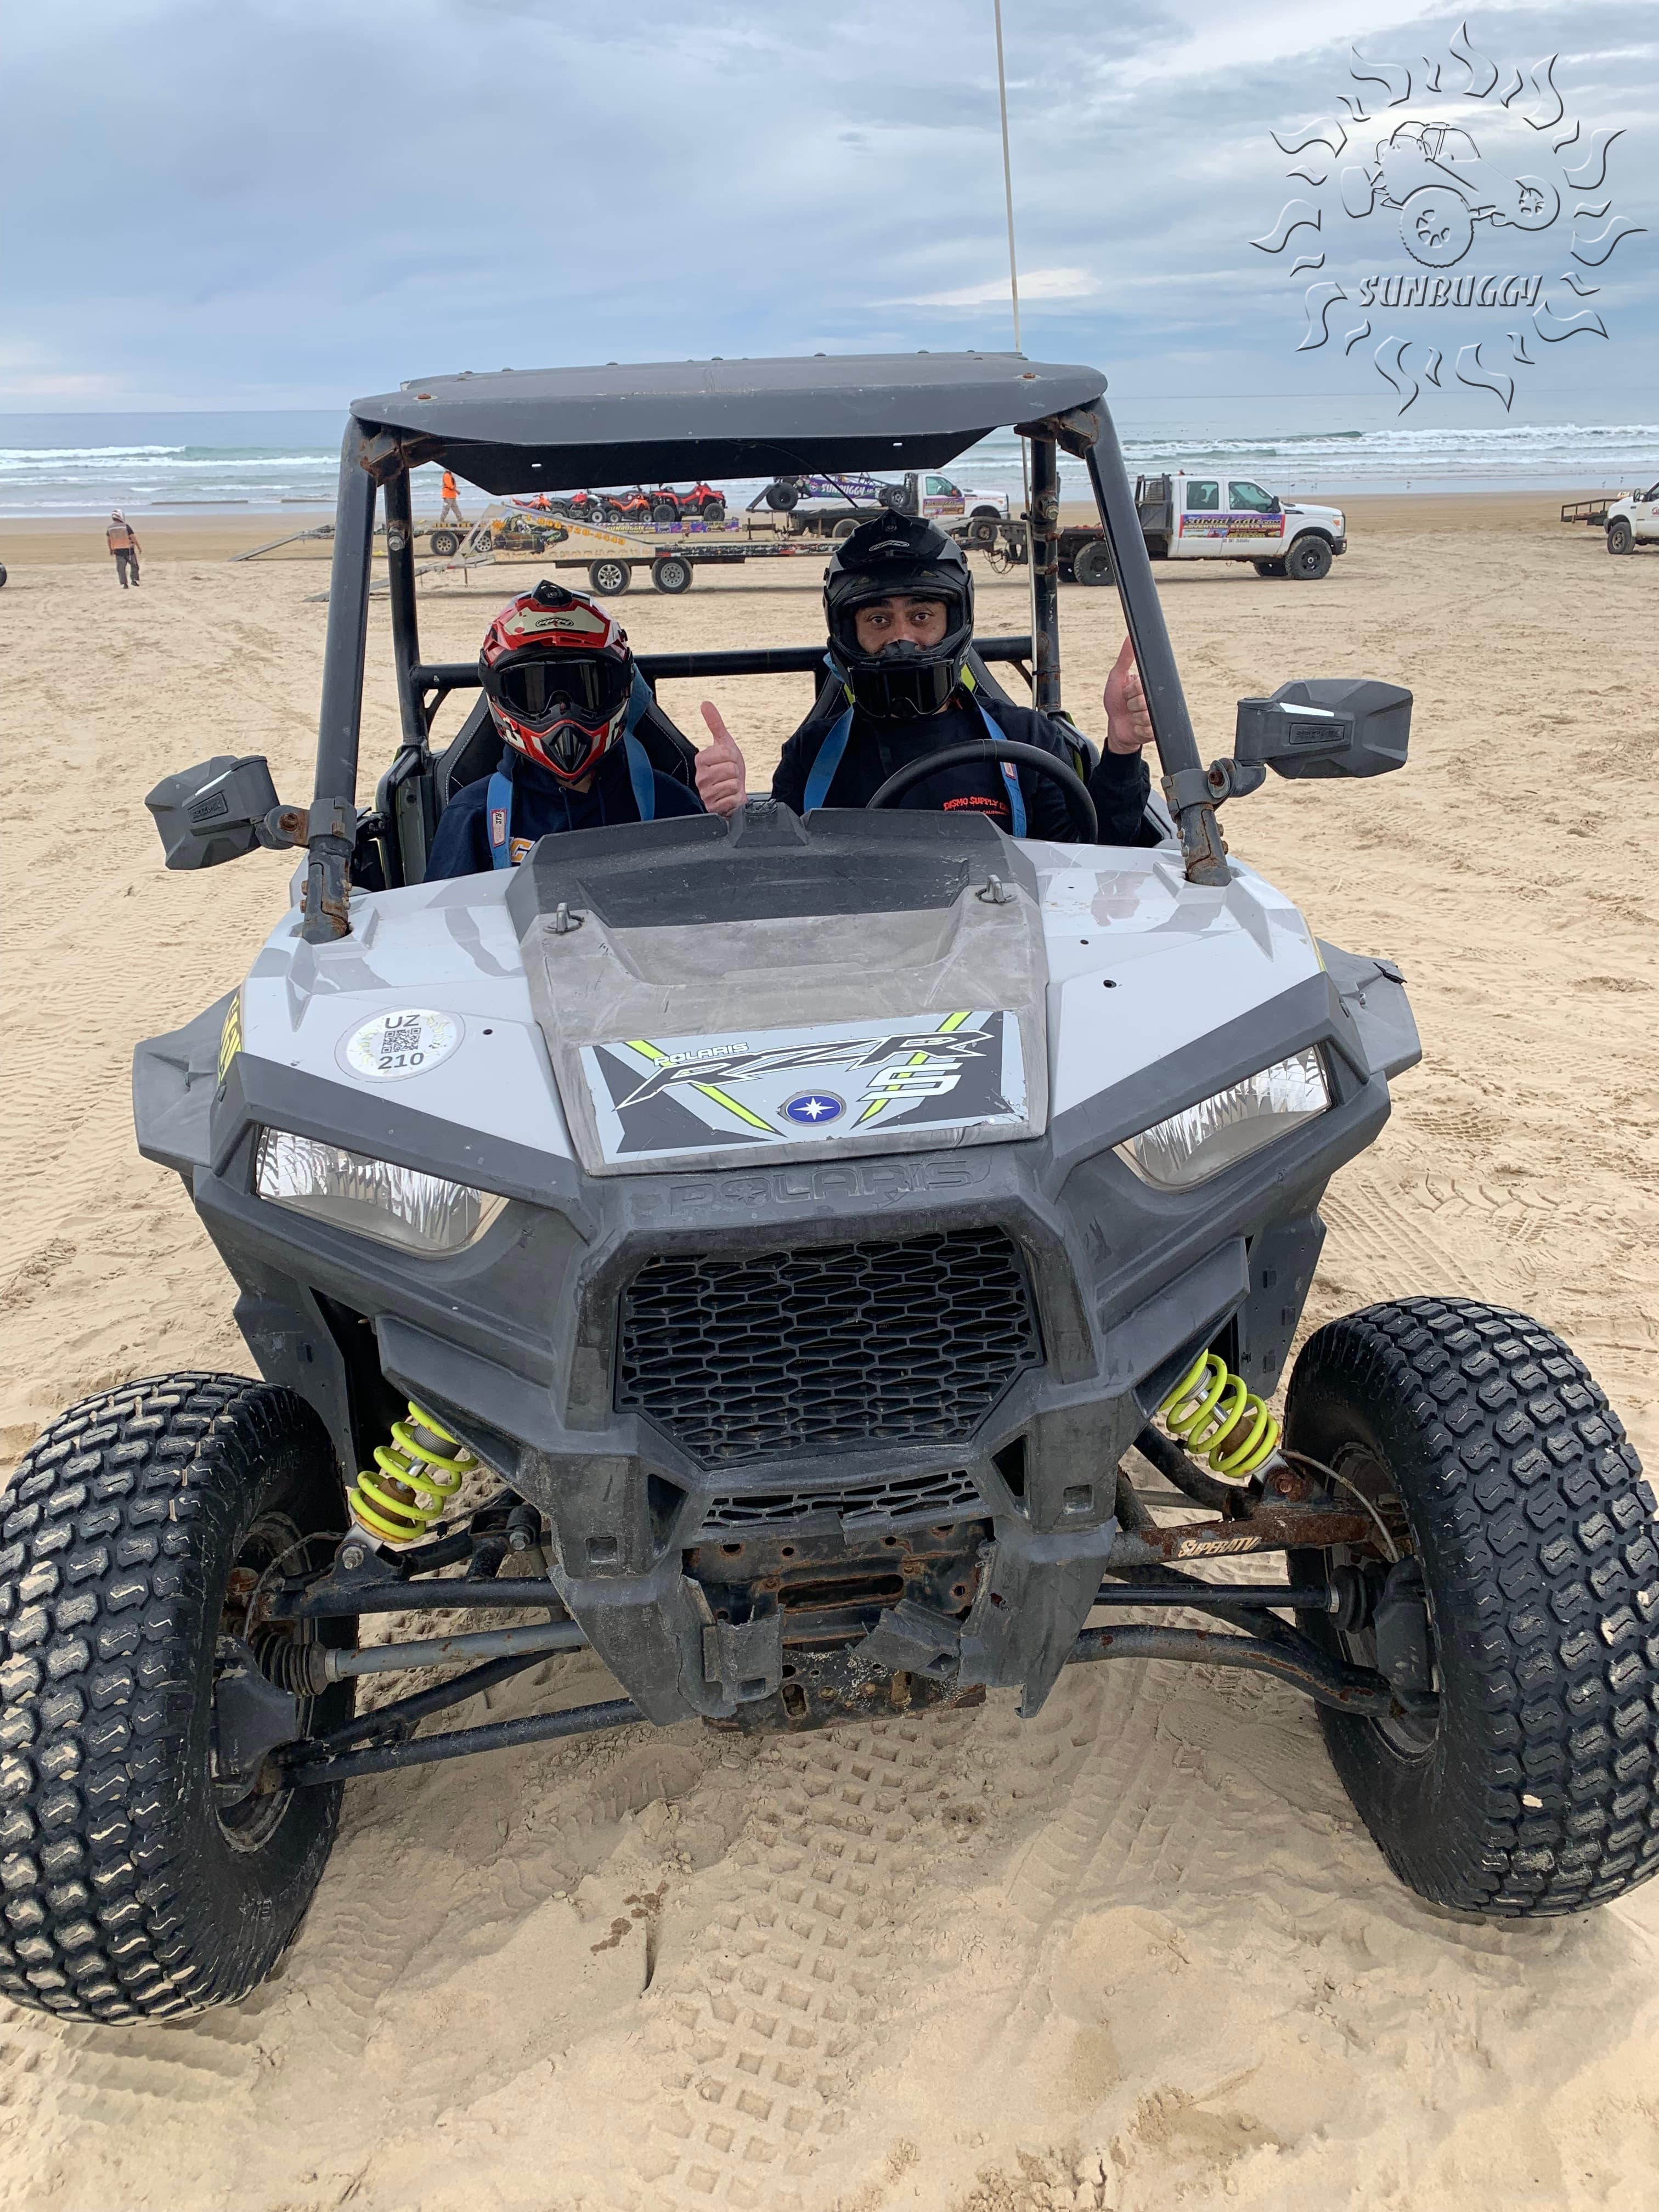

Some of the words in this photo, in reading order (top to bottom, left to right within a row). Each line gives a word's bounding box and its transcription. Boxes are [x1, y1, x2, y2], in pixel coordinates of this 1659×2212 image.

[969, 796, 998, 807] SUPPLY
[385, 1014, 420, 1029] UZ
[377, 1052, 425, 1070] 210
[654, 1043, 749, 1066] POLARIS
[616, 1030, 994, 1110] RZR
[670, 1160, 973, 1216] POLARIS
